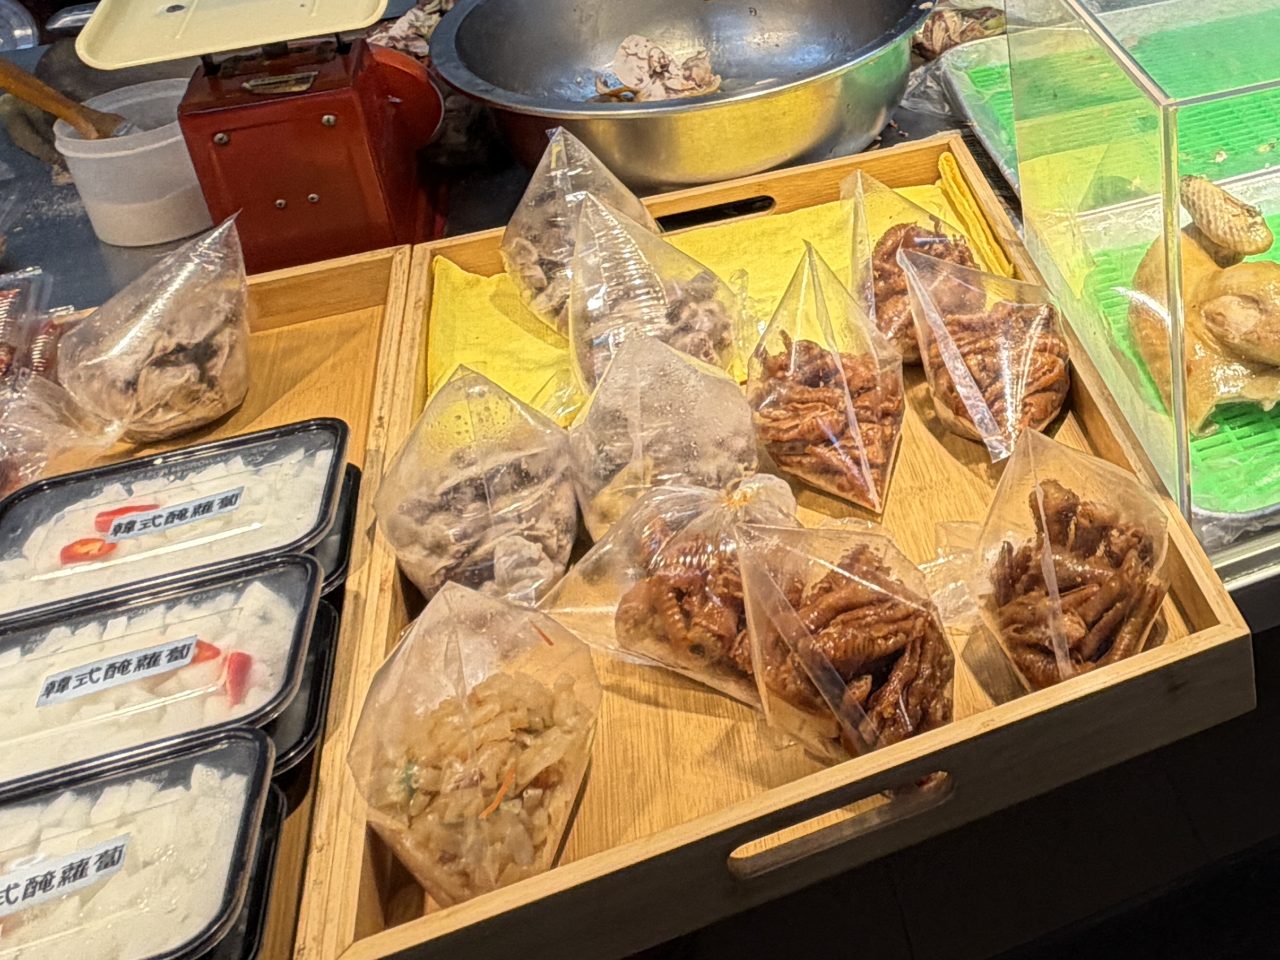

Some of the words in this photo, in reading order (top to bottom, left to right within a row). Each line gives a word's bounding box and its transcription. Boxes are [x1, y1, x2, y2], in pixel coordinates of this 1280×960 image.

[108, 492, 242, 538] 韓式醃蘿蔔
[42, 642, 195, 700] 韓式醃蘿蔔
